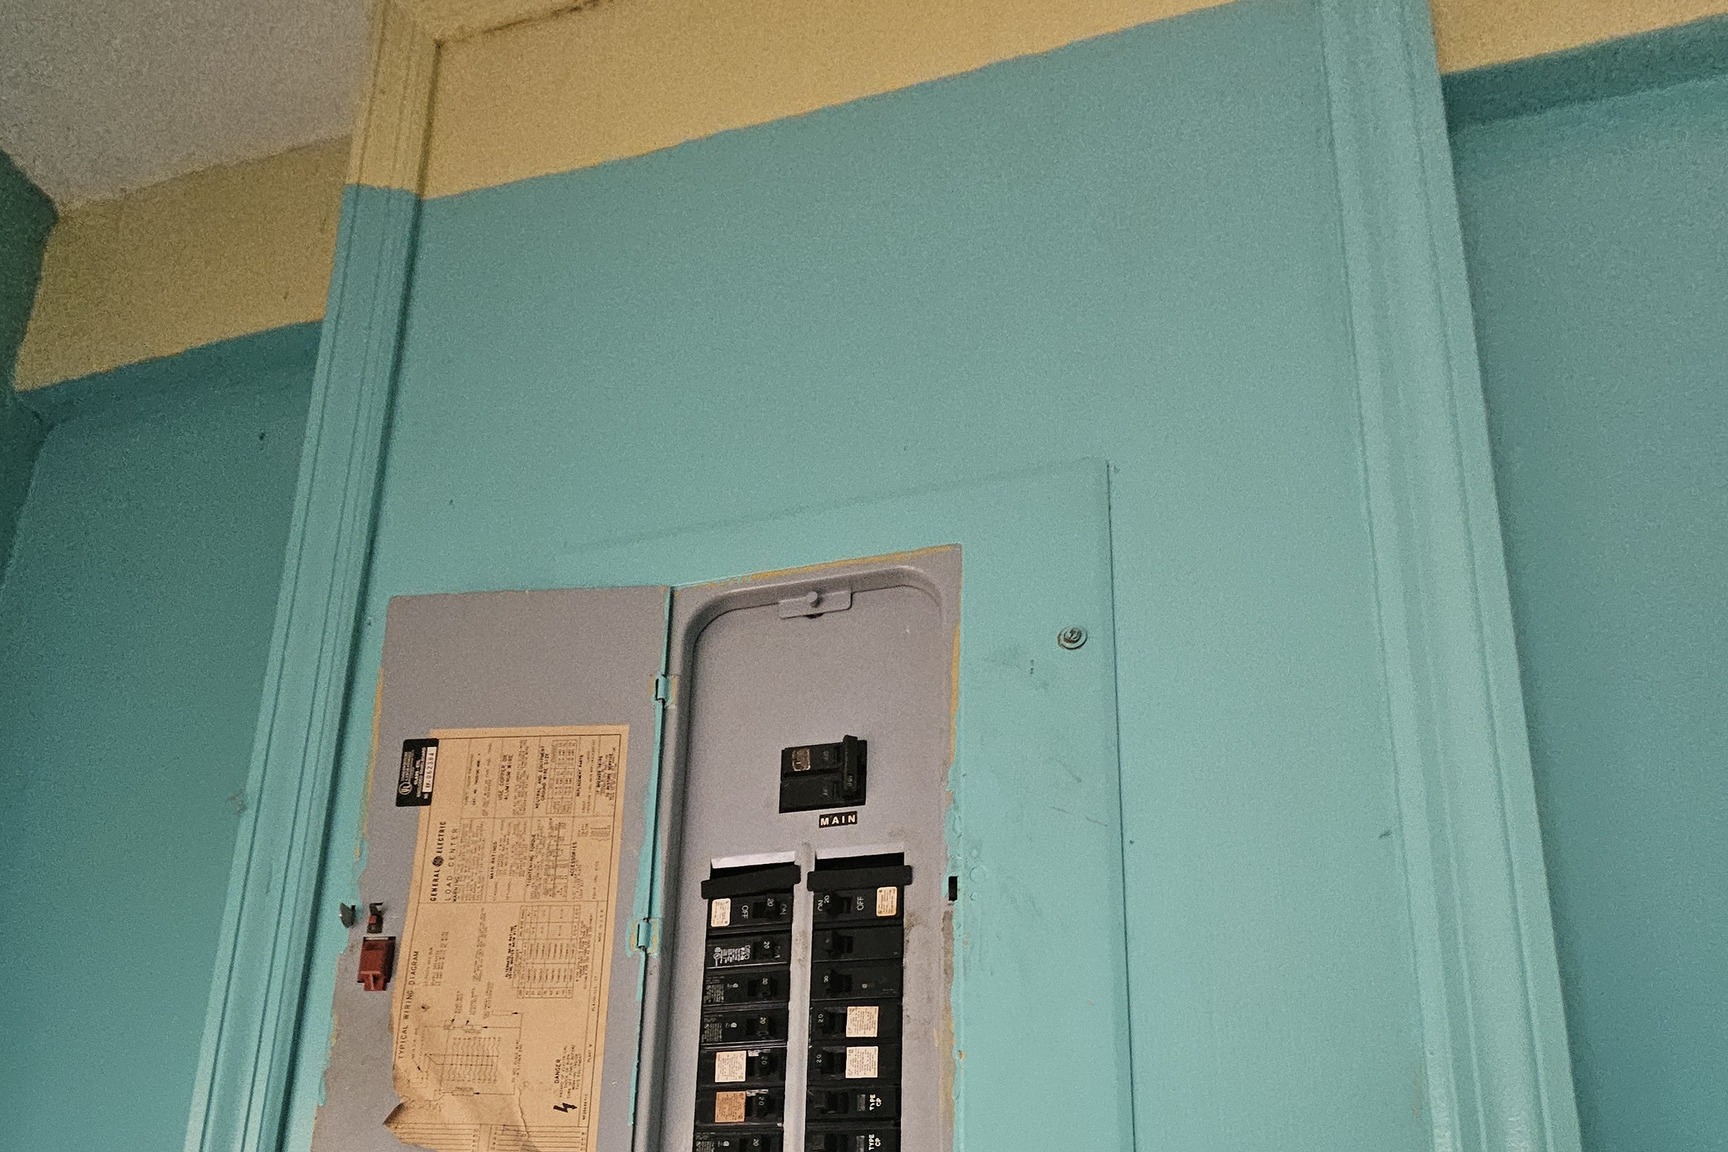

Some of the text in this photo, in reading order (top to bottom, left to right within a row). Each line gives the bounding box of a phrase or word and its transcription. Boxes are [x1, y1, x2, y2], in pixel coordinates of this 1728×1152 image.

[820, 814, 856, 826] MAIN
[430, 821, 446, 902] GENERAL ELECTRIC
[444, 828, 458, 901] LOAD CENTER
[767, 898, 774, 907] 20
[856, 896, 864, 910] OFF
[408, 950, 419, 986] DIAGRAM
[402, 990, 414, 1020] WIRING
[398, 1025, 408, 1060] TYPICAL
[554, 1058, 562, 1084] DANGER
[875, 1098, 882, 1107] CP
[874, 1138, 882, 1147] CP
